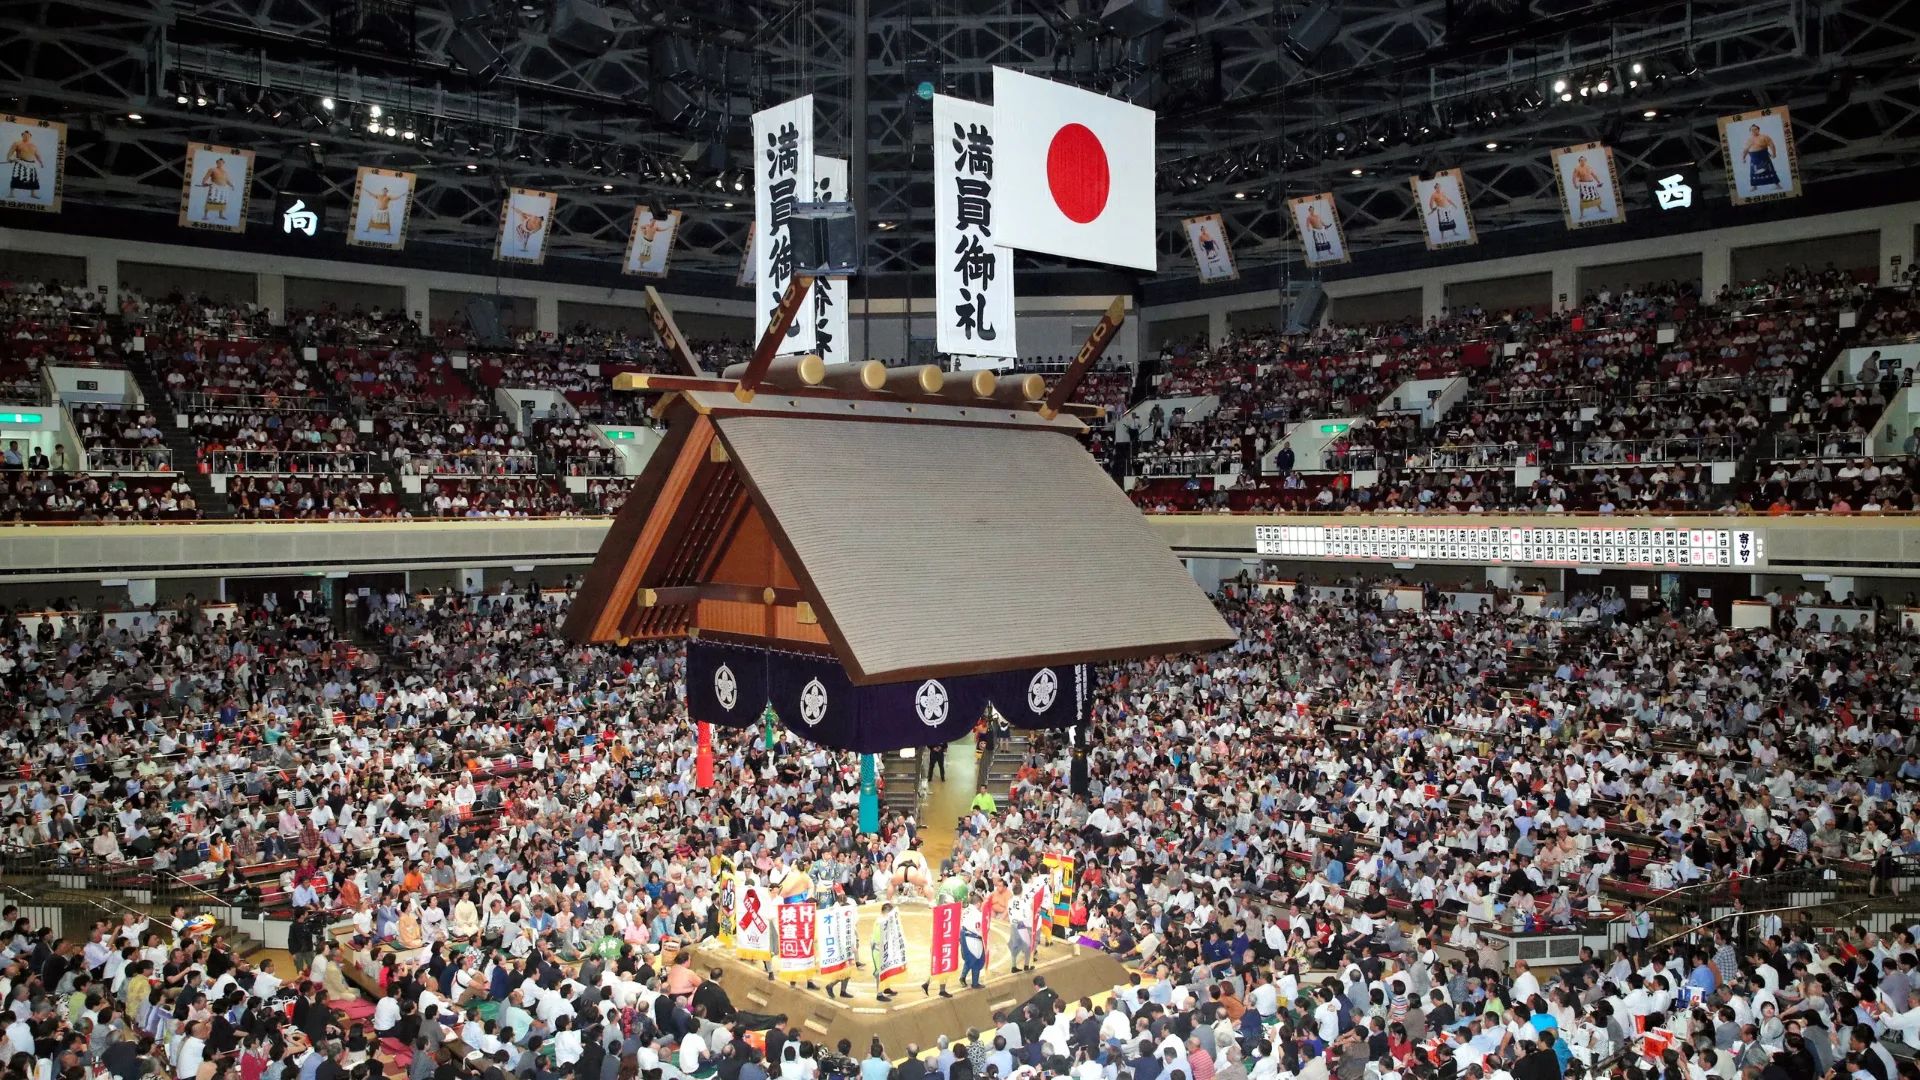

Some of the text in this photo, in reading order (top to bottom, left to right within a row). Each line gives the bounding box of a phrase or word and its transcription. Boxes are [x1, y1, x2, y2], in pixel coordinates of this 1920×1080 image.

[1655, 173, 1692, 210] 西
[283, 199, 318, 236] 向
[953, 122, 996, 341] 満員御礼
[1739, 532, 1750, 563] 寄り切り
[781, 906, 798, 939] 検査
[799, 906, 814, 955] HIV
[823, 914, 836, 958] オーロラ
